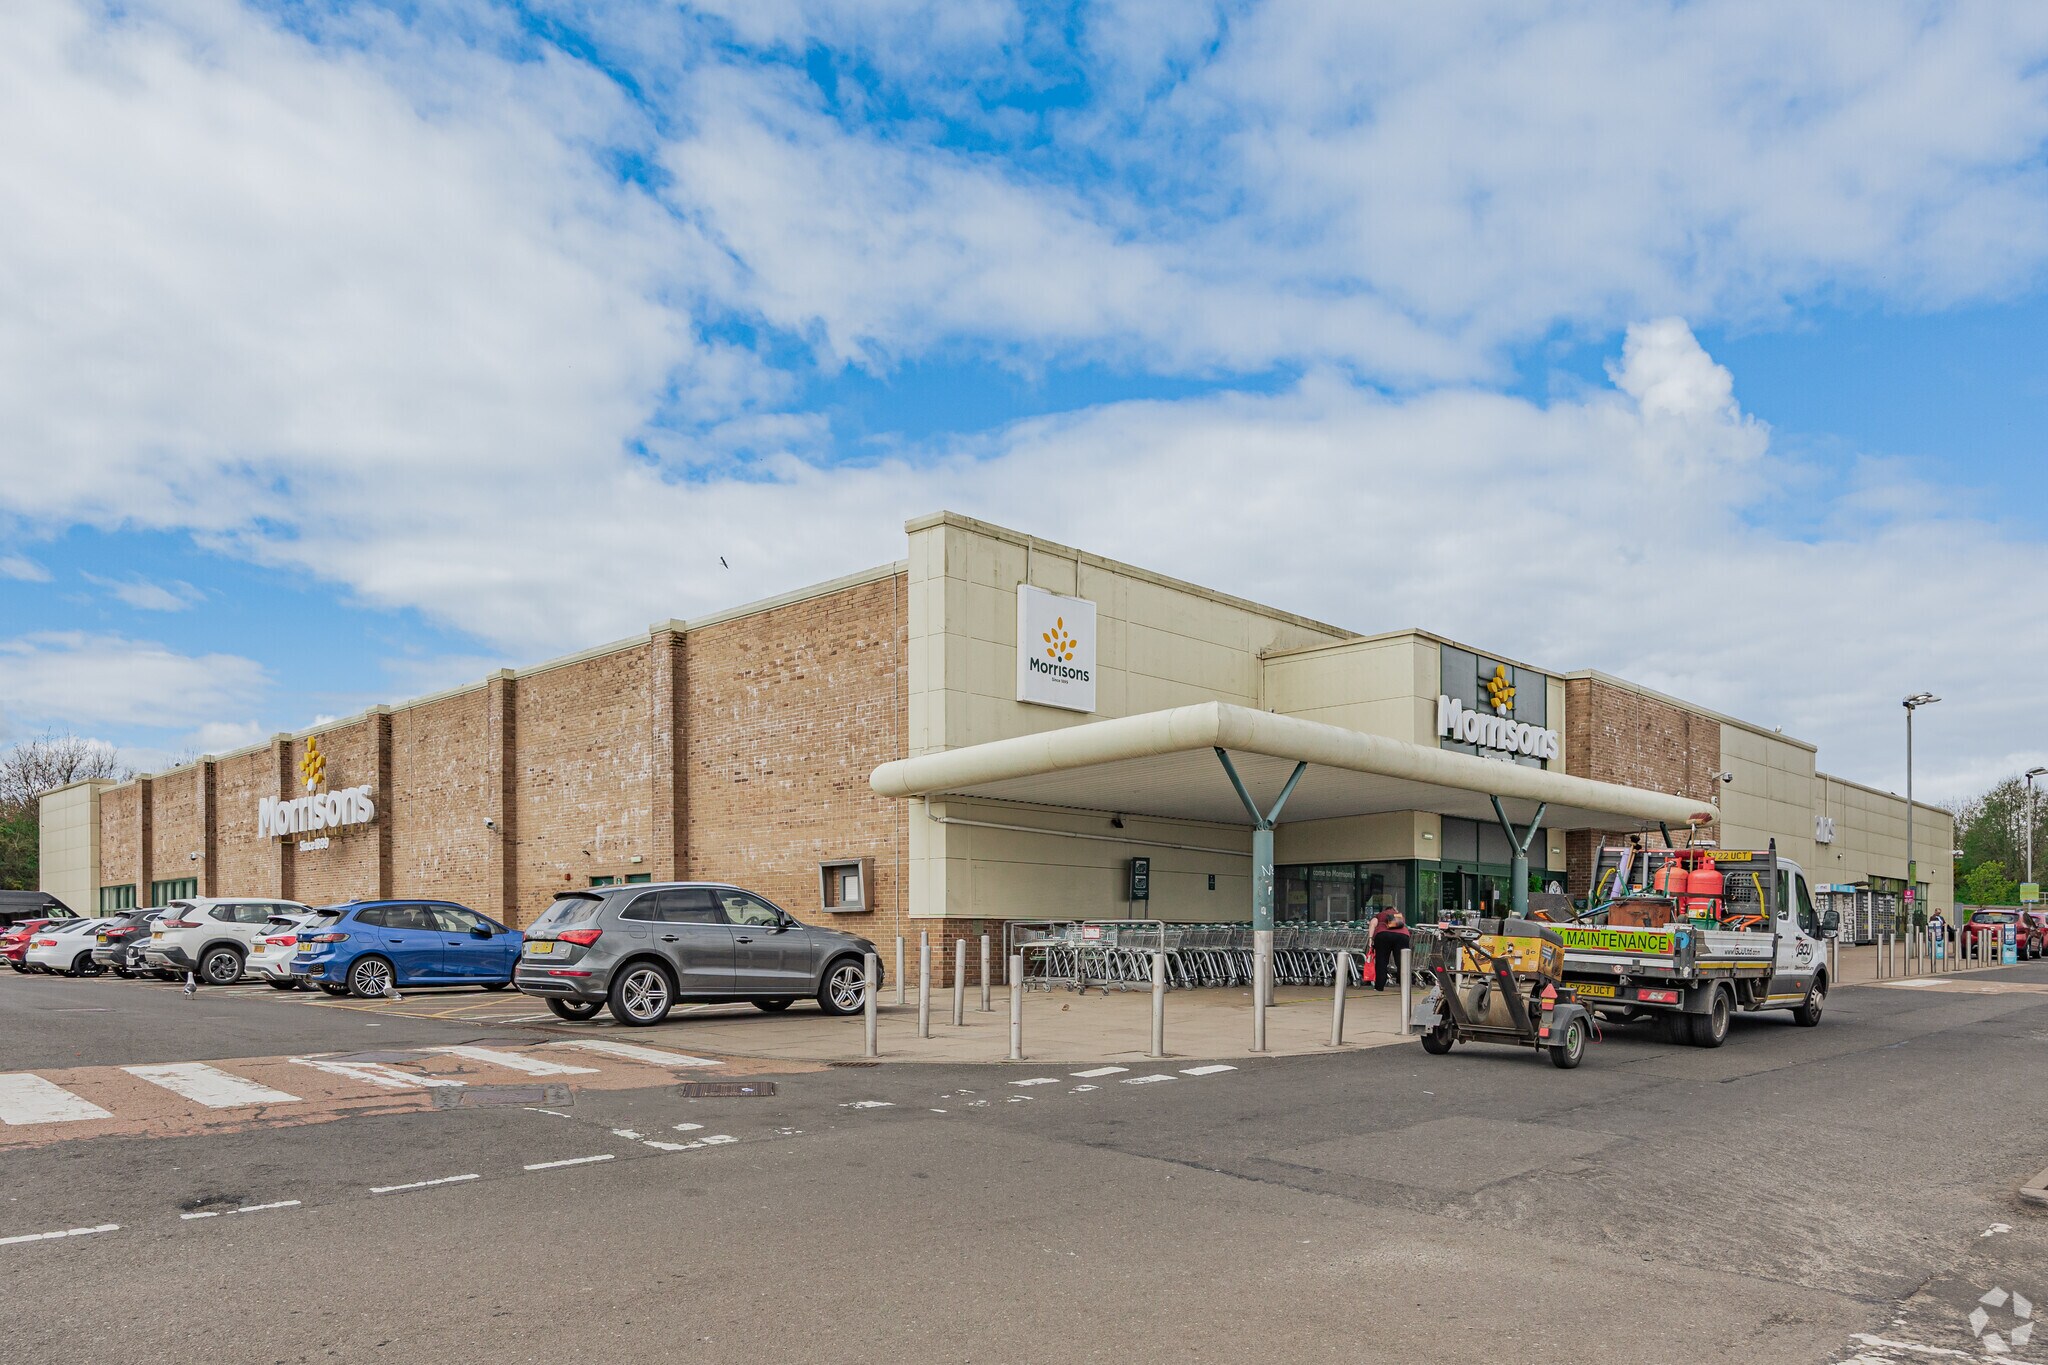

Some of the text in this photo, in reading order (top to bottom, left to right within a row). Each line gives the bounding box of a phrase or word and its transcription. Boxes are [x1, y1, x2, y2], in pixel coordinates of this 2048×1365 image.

[1029, 656, 1090, 682] Morrisons
[1438, 694, 1559, 760] Morrisons
[258, 778, 375, 838] Morrisons
[1731, 851, 1748, 860] UCT
[1567, 931, 1667, 950] MAINTENANCE
[1594, 985, 1611, 995] UCT
